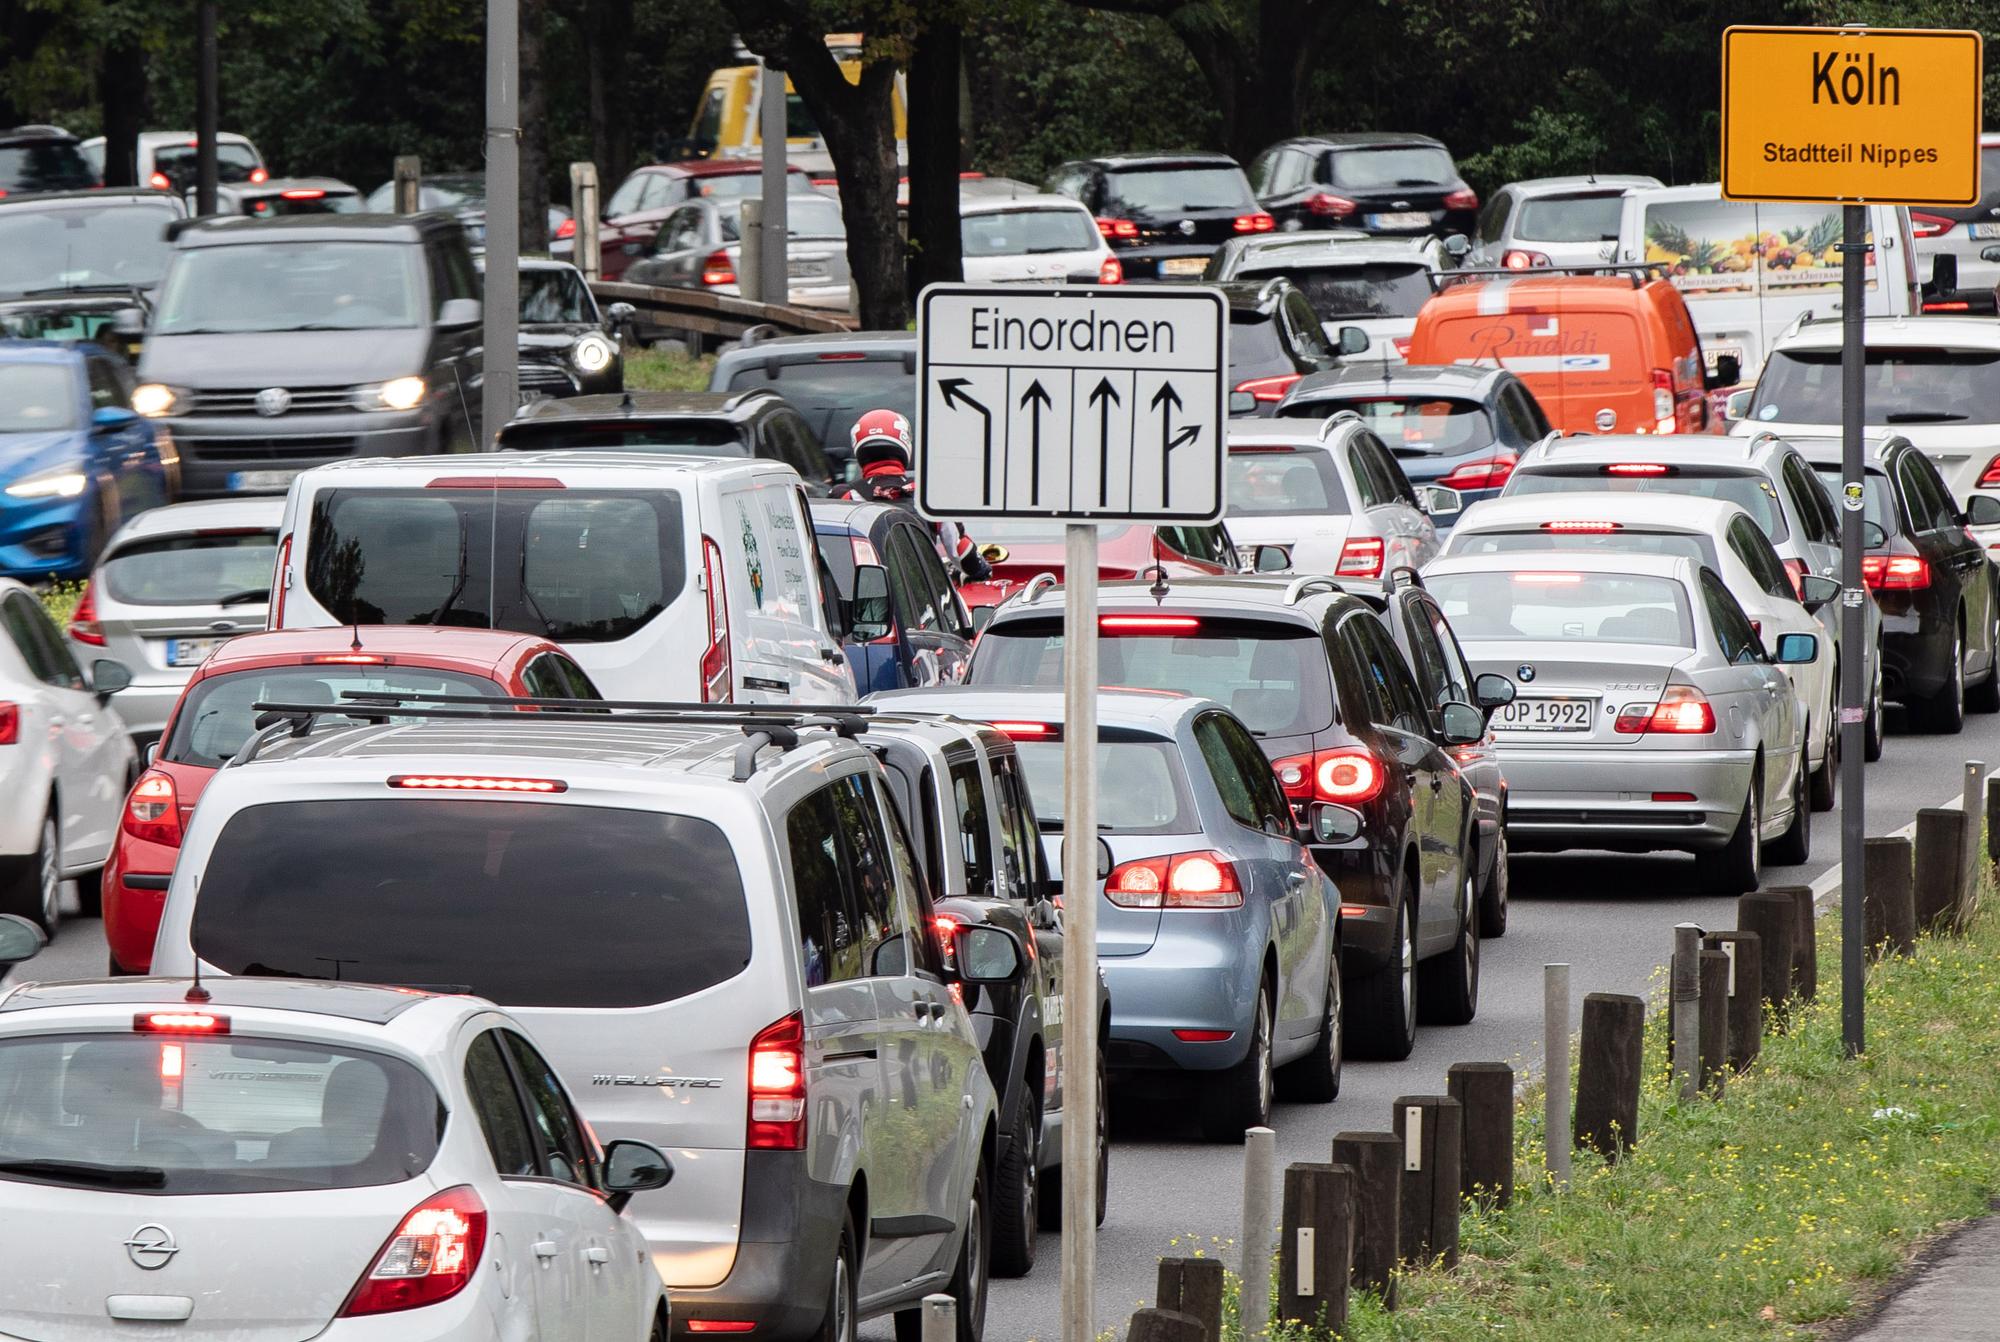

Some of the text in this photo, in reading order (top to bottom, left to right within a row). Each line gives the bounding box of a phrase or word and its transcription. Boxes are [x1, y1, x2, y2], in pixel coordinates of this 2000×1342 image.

[1812, 51, 1900, 106] Köln
[1763, 142, 1938, 168] Stadtteil Nippes
[970, 306, 1175, 354] Einordnen
[1503, 702, 1587, 724] OP 1992
